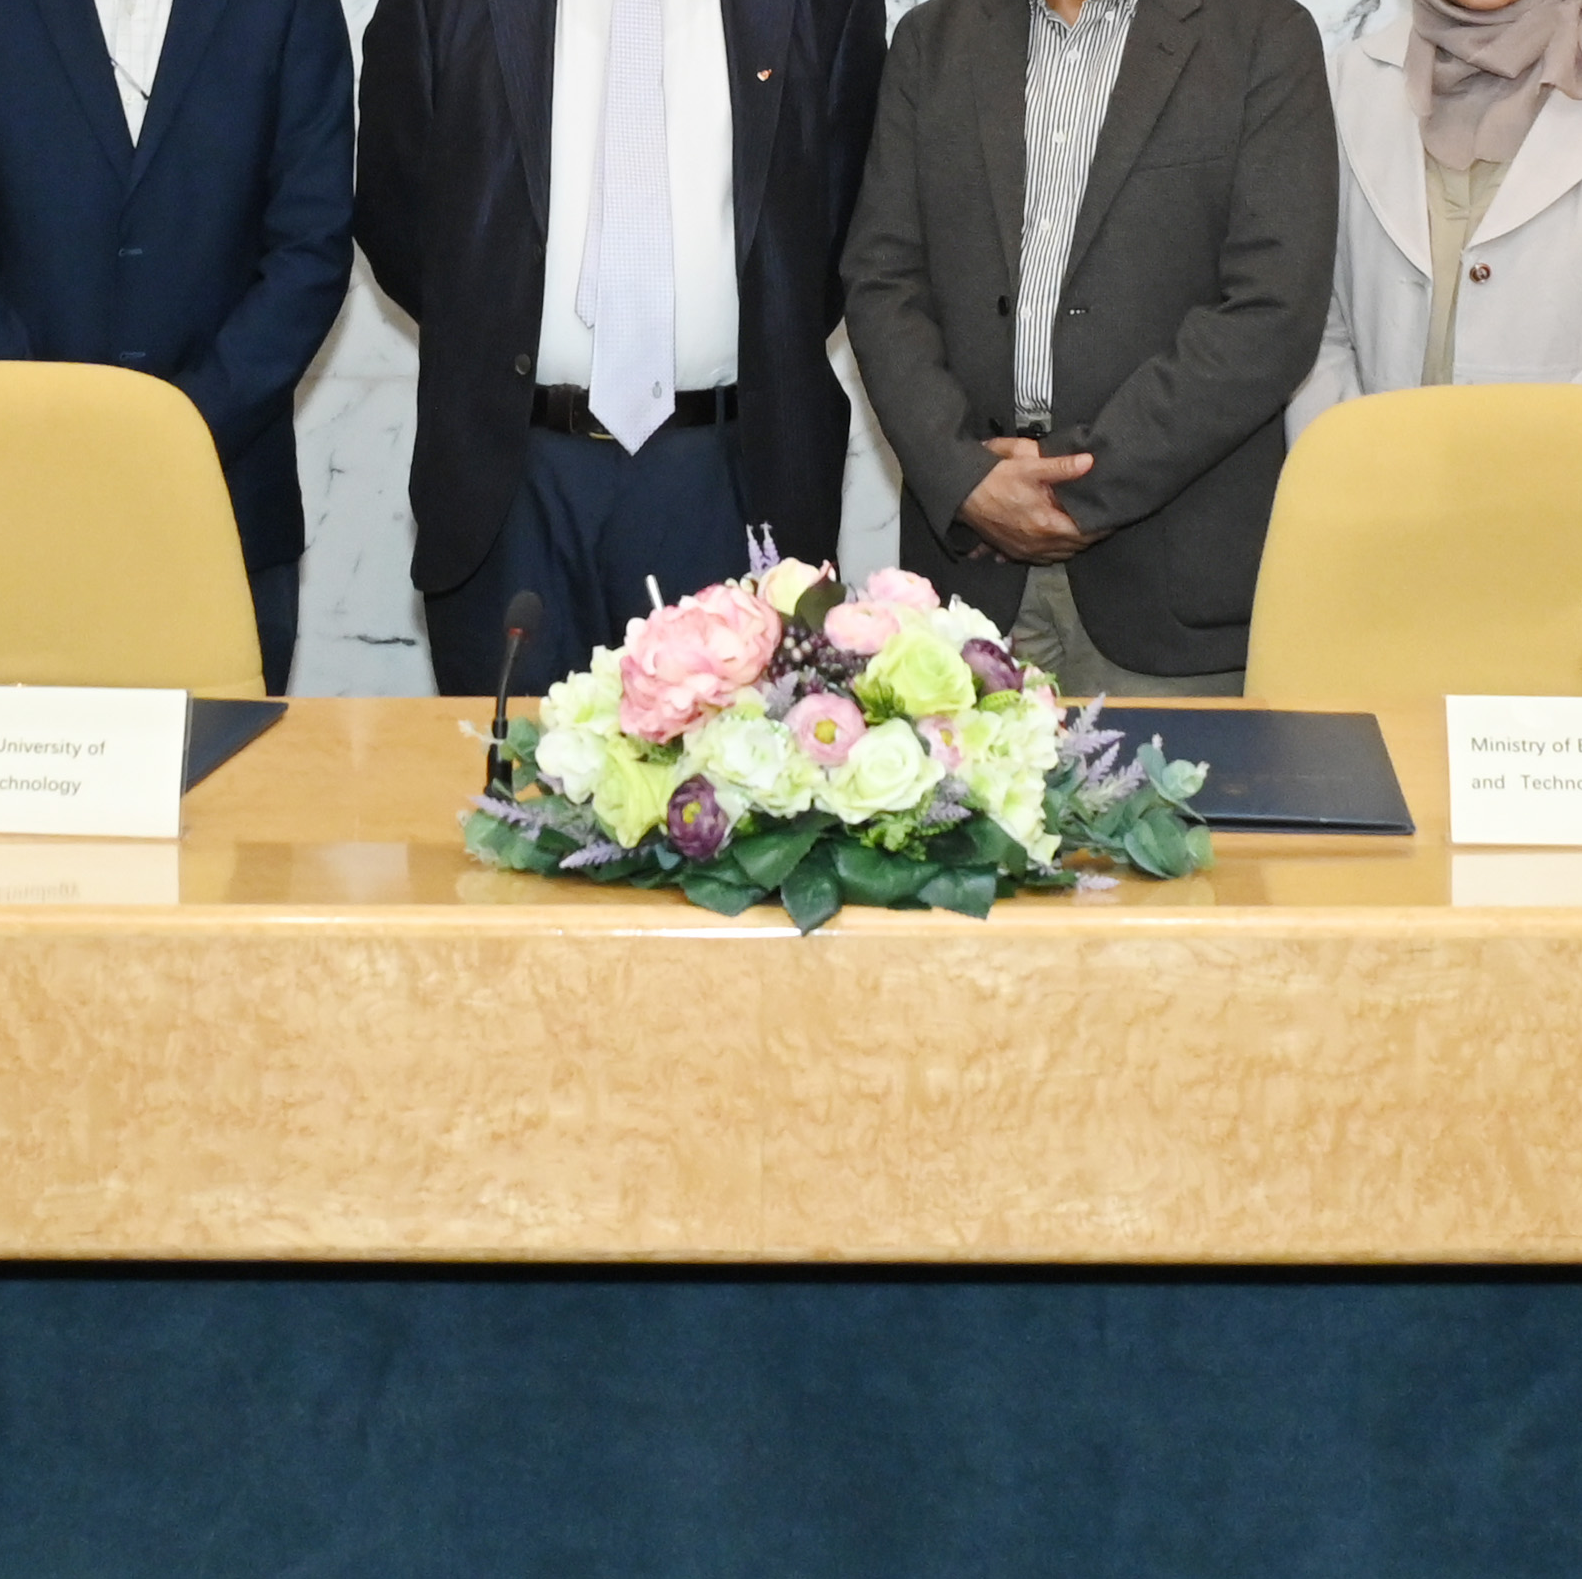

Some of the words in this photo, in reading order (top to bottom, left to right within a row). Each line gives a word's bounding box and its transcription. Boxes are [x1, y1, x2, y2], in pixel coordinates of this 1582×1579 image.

[87, 740, 106, 756] of
[1471, 737, 1546, 756] Ministry
[1552, 737, 1571, 753] of
[1471, 774, 1506, 790] and
